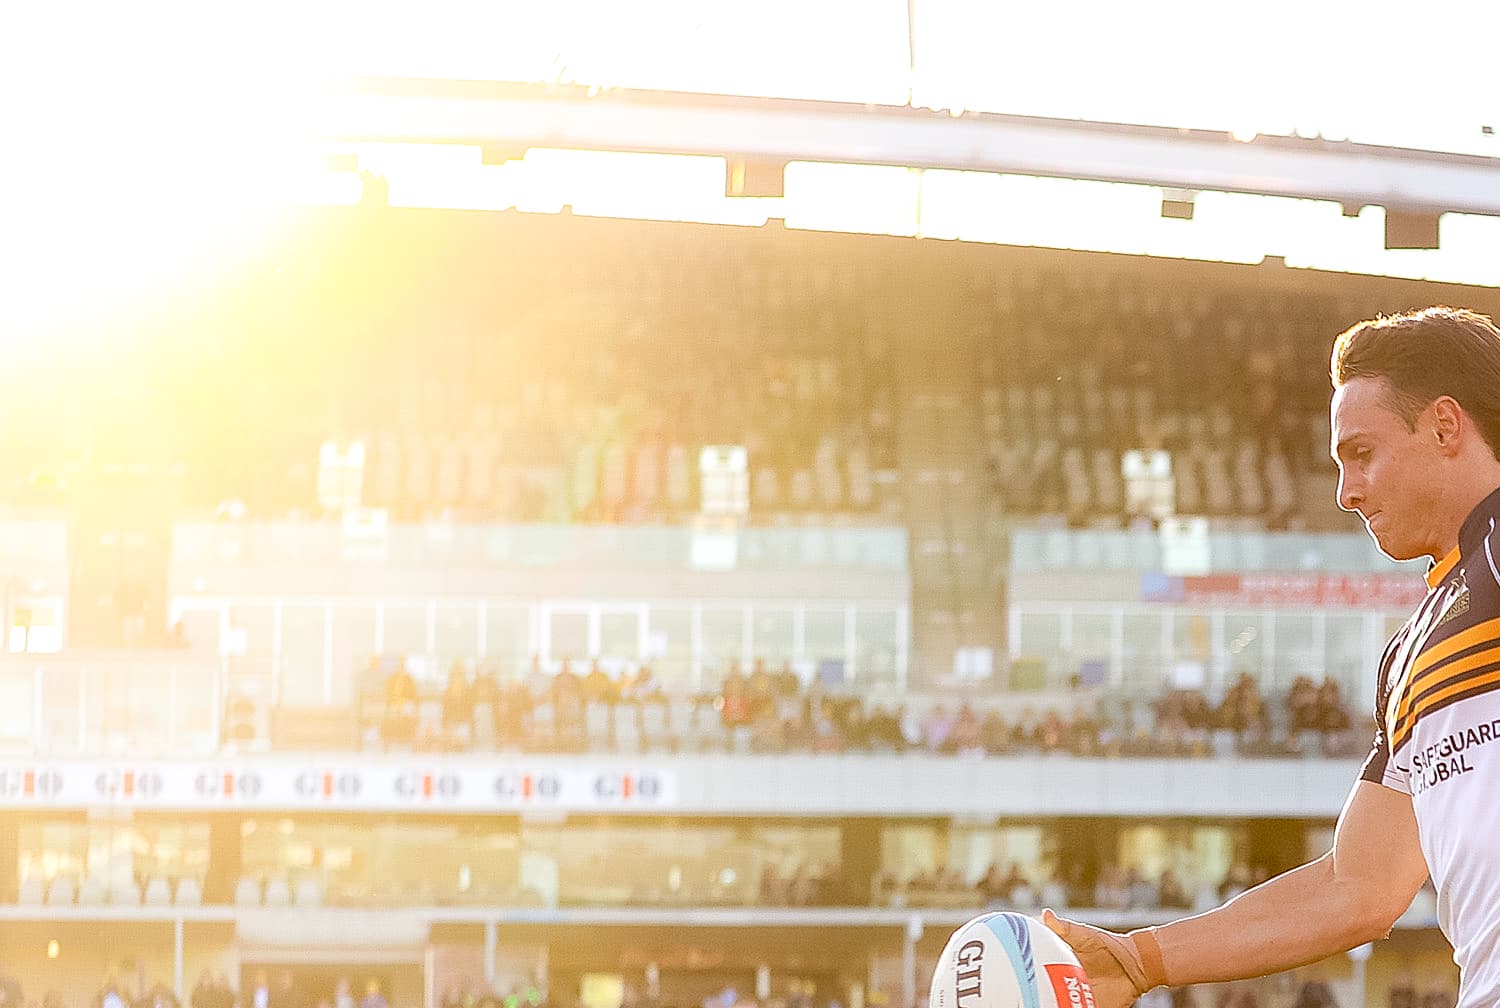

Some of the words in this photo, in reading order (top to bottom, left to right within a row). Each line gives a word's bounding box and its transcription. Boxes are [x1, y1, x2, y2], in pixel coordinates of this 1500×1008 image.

[95, 768, 163, 798] GIO
[194, 768, 262, 798] GIO
[293, 768, 361, 798] GIO
[394, 770, 461, 800] GIO
[494, 770, 561, 800] GIO
[594, 770, 659, 800] GIO
